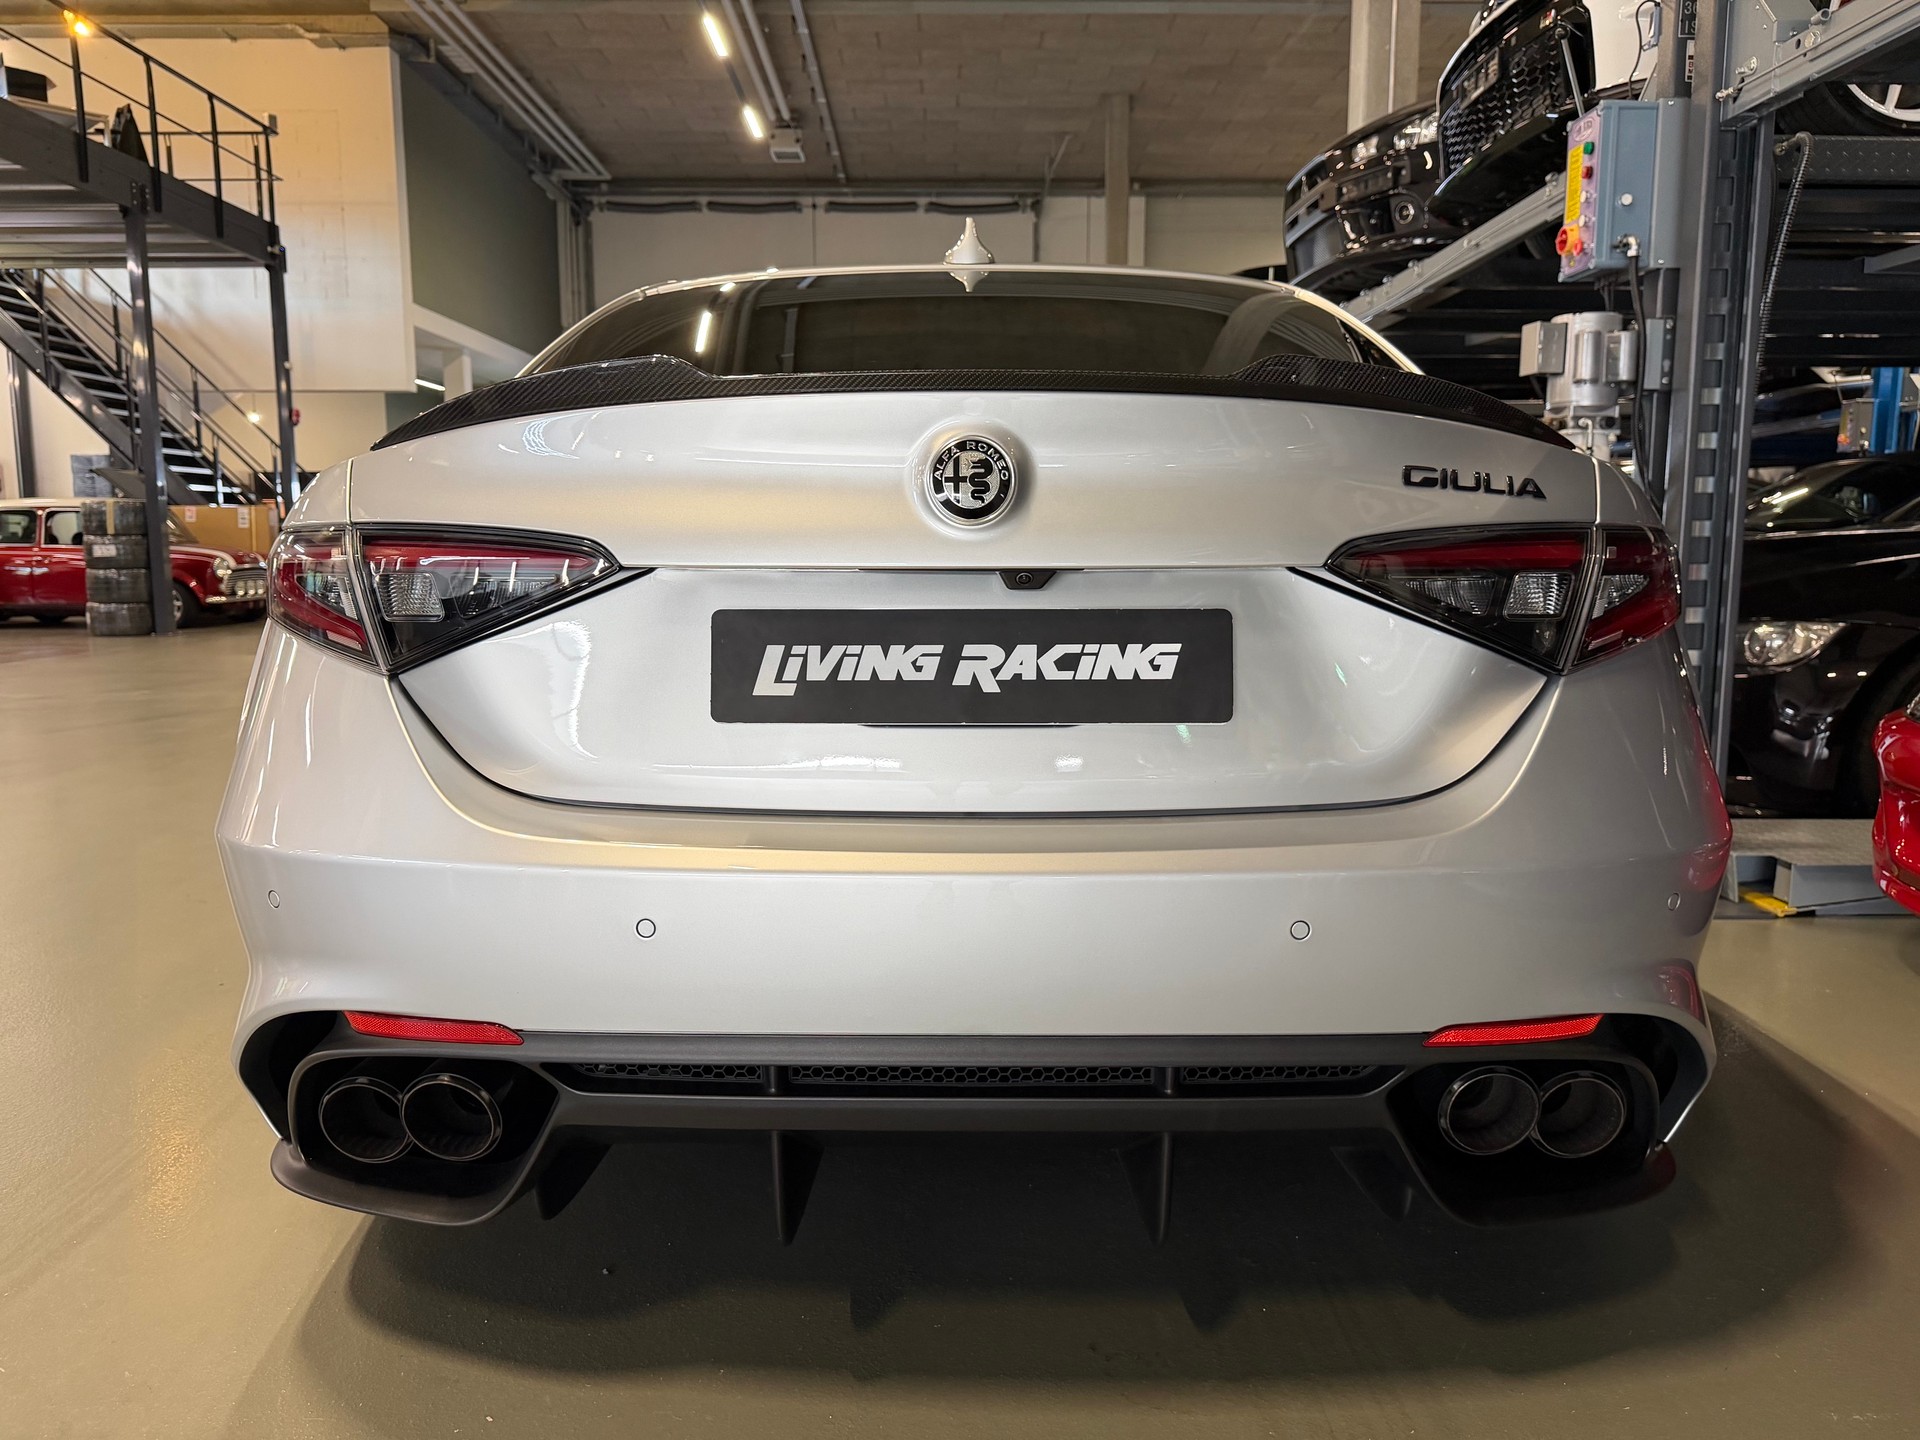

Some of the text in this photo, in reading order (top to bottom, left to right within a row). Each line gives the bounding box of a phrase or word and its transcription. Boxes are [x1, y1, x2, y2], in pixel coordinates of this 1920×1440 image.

[933, 440, 1009, 481] ALFA ROMEO
[1402, 465, 1547, 500] GIULIA
